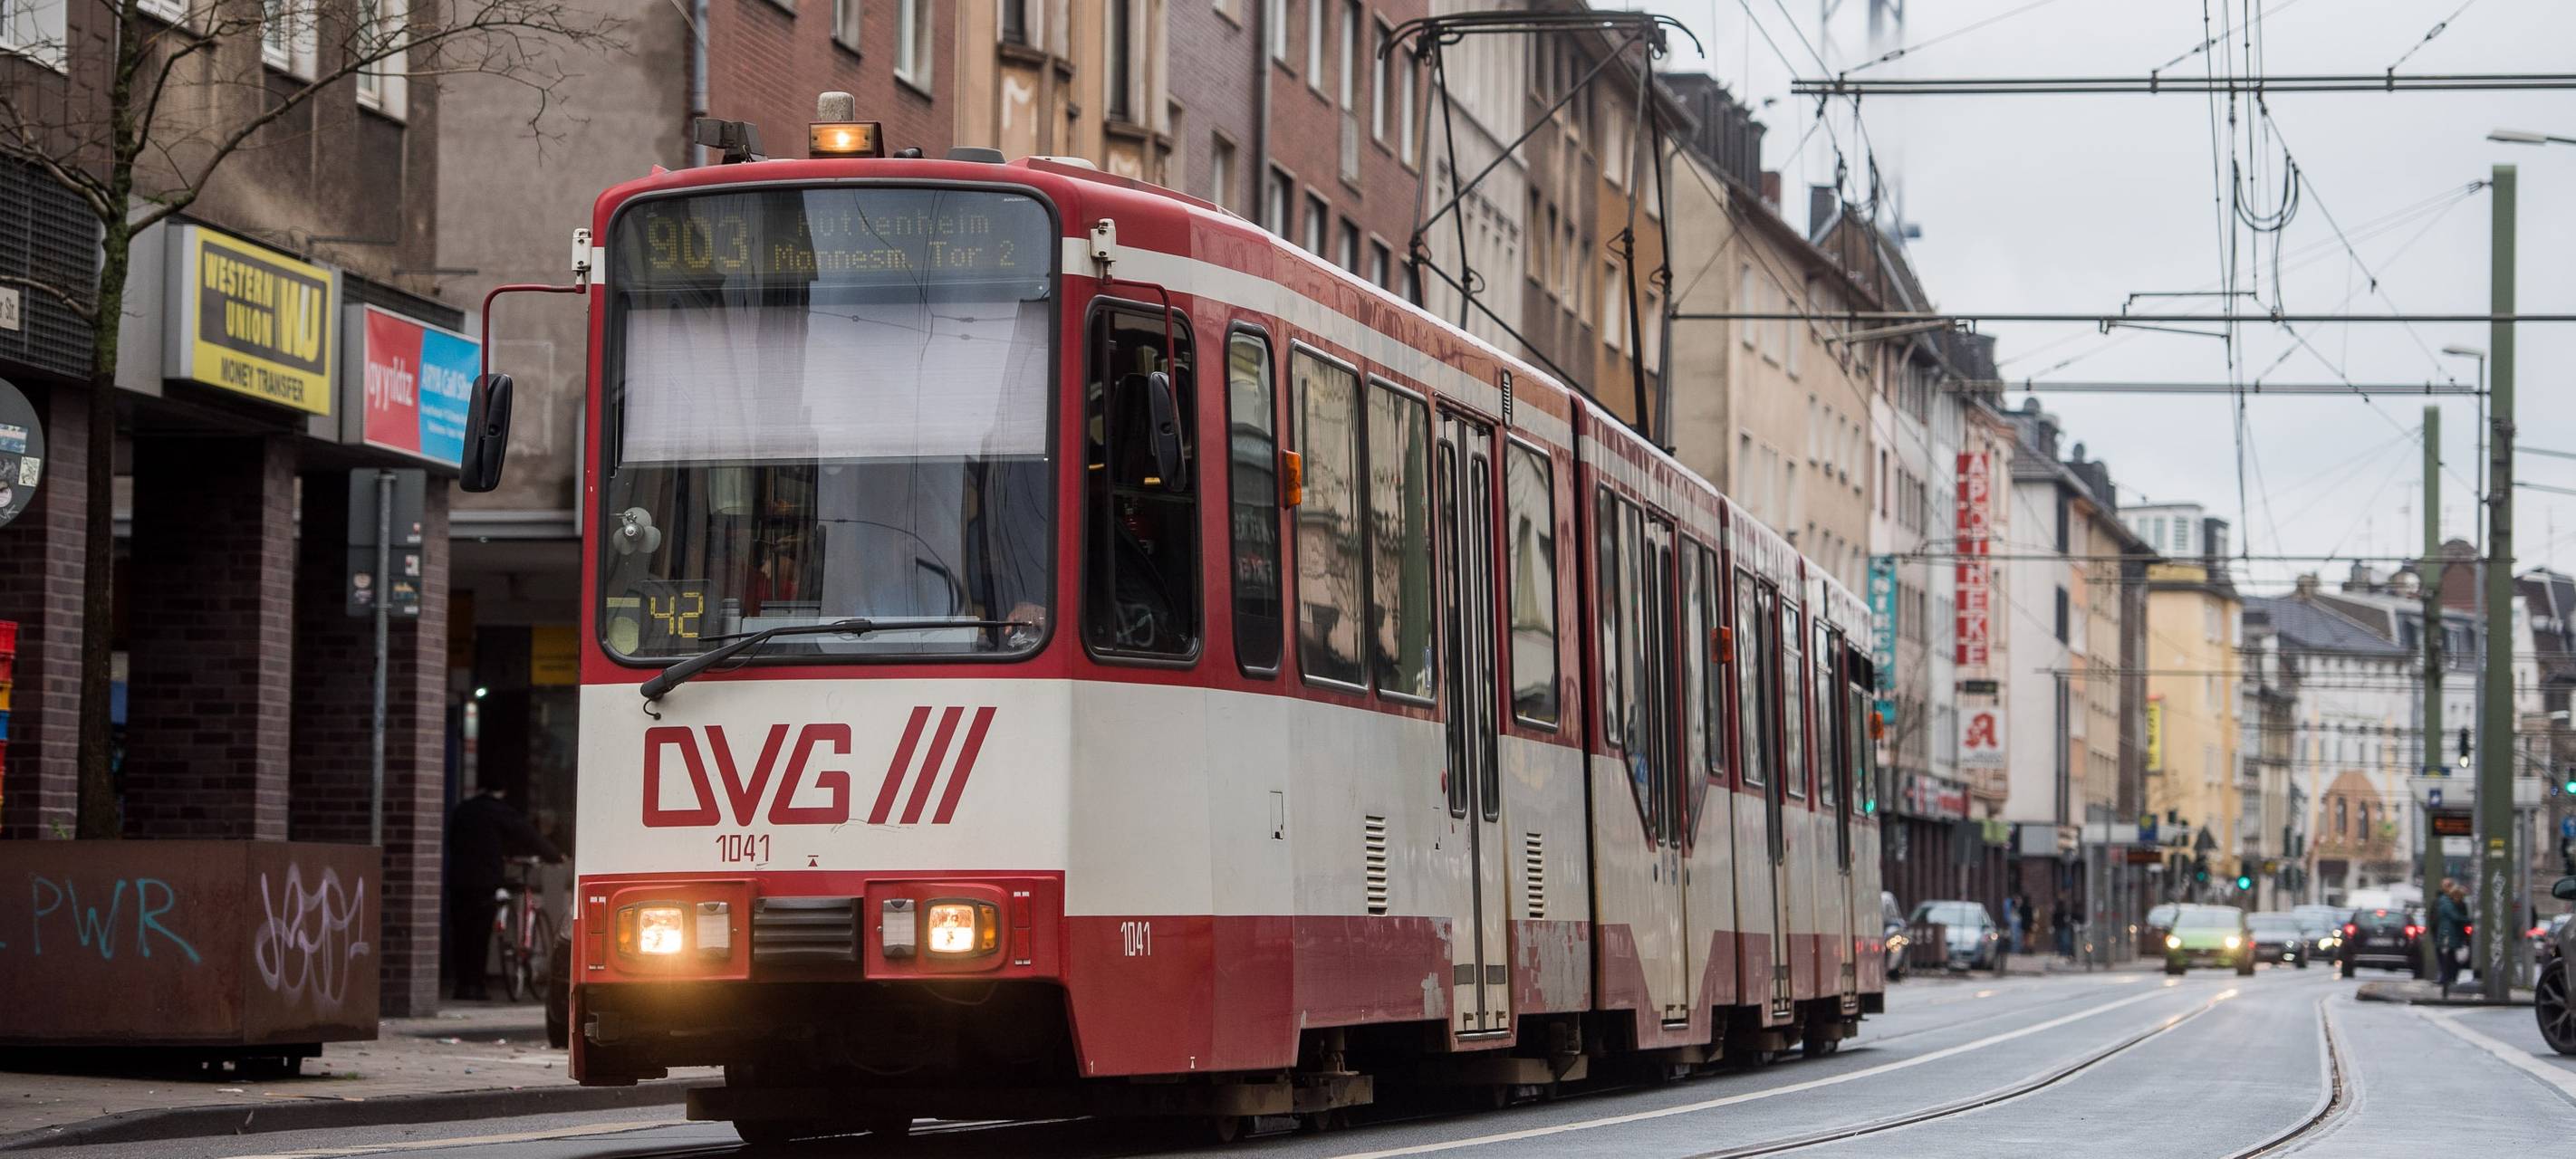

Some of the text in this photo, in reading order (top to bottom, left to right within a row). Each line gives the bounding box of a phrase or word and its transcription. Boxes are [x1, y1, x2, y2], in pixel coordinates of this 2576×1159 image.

[648, 215, 749, 269] 903
[797, 209, 991, 236] Hüttenheim
[928, 240, 983, 268] Tor
[999, 240, 1015, 266] 2
[205, 251, 274, 309] WESTERN
[226, 299, 273, 349] UNION
[281, 276, 322, 362] WU
[220, 357, 304, 404] MONEY TRANSFER
[1966, 454, 1989, 666] APOTHEKE
[649, 591, 704, 638] 42
[716, 834, 770, 863] 1041
[30, 875, 201, 964] PWR
[1120, 921, 1151, 957] 1041
